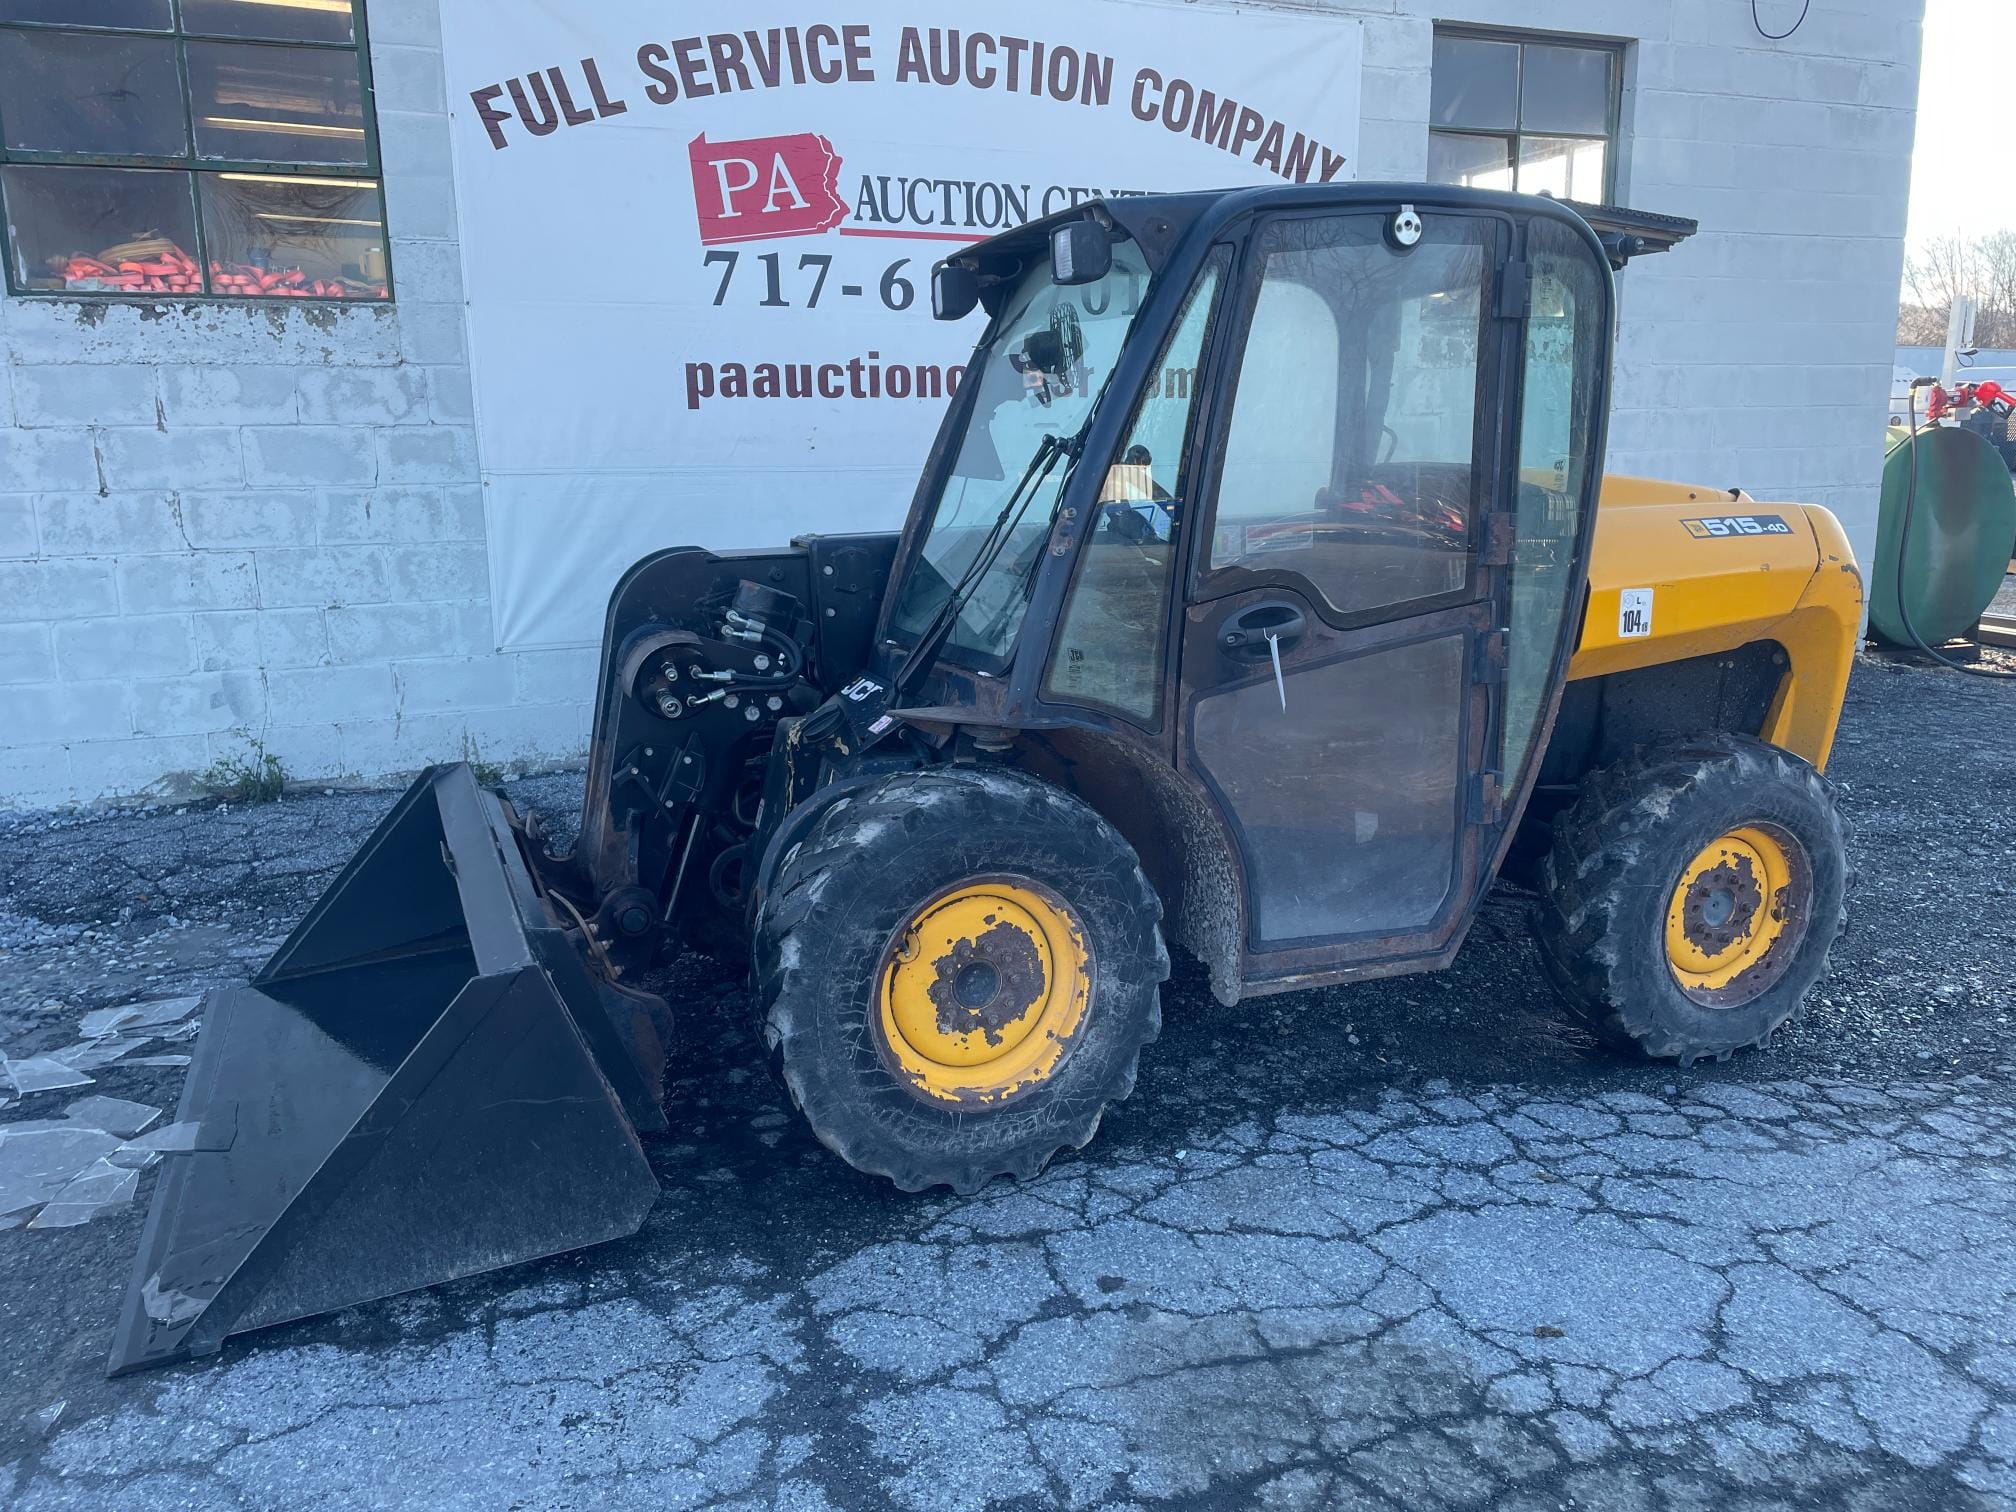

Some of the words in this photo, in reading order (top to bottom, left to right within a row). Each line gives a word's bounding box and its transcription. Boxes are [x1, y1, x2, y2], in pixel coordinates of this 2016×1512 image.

[469, 57, 628, 150] FULL
[636, 23, 876, 106] SERVICE
[895, 26, 1115, 107] AUCTION
[1131, 68, 1348, 184] COMPANY
[708, 152, 811, 219] PA
[853, 174, 1031, 229] AUCTION
[1622, 610, 1642, 633] 104
